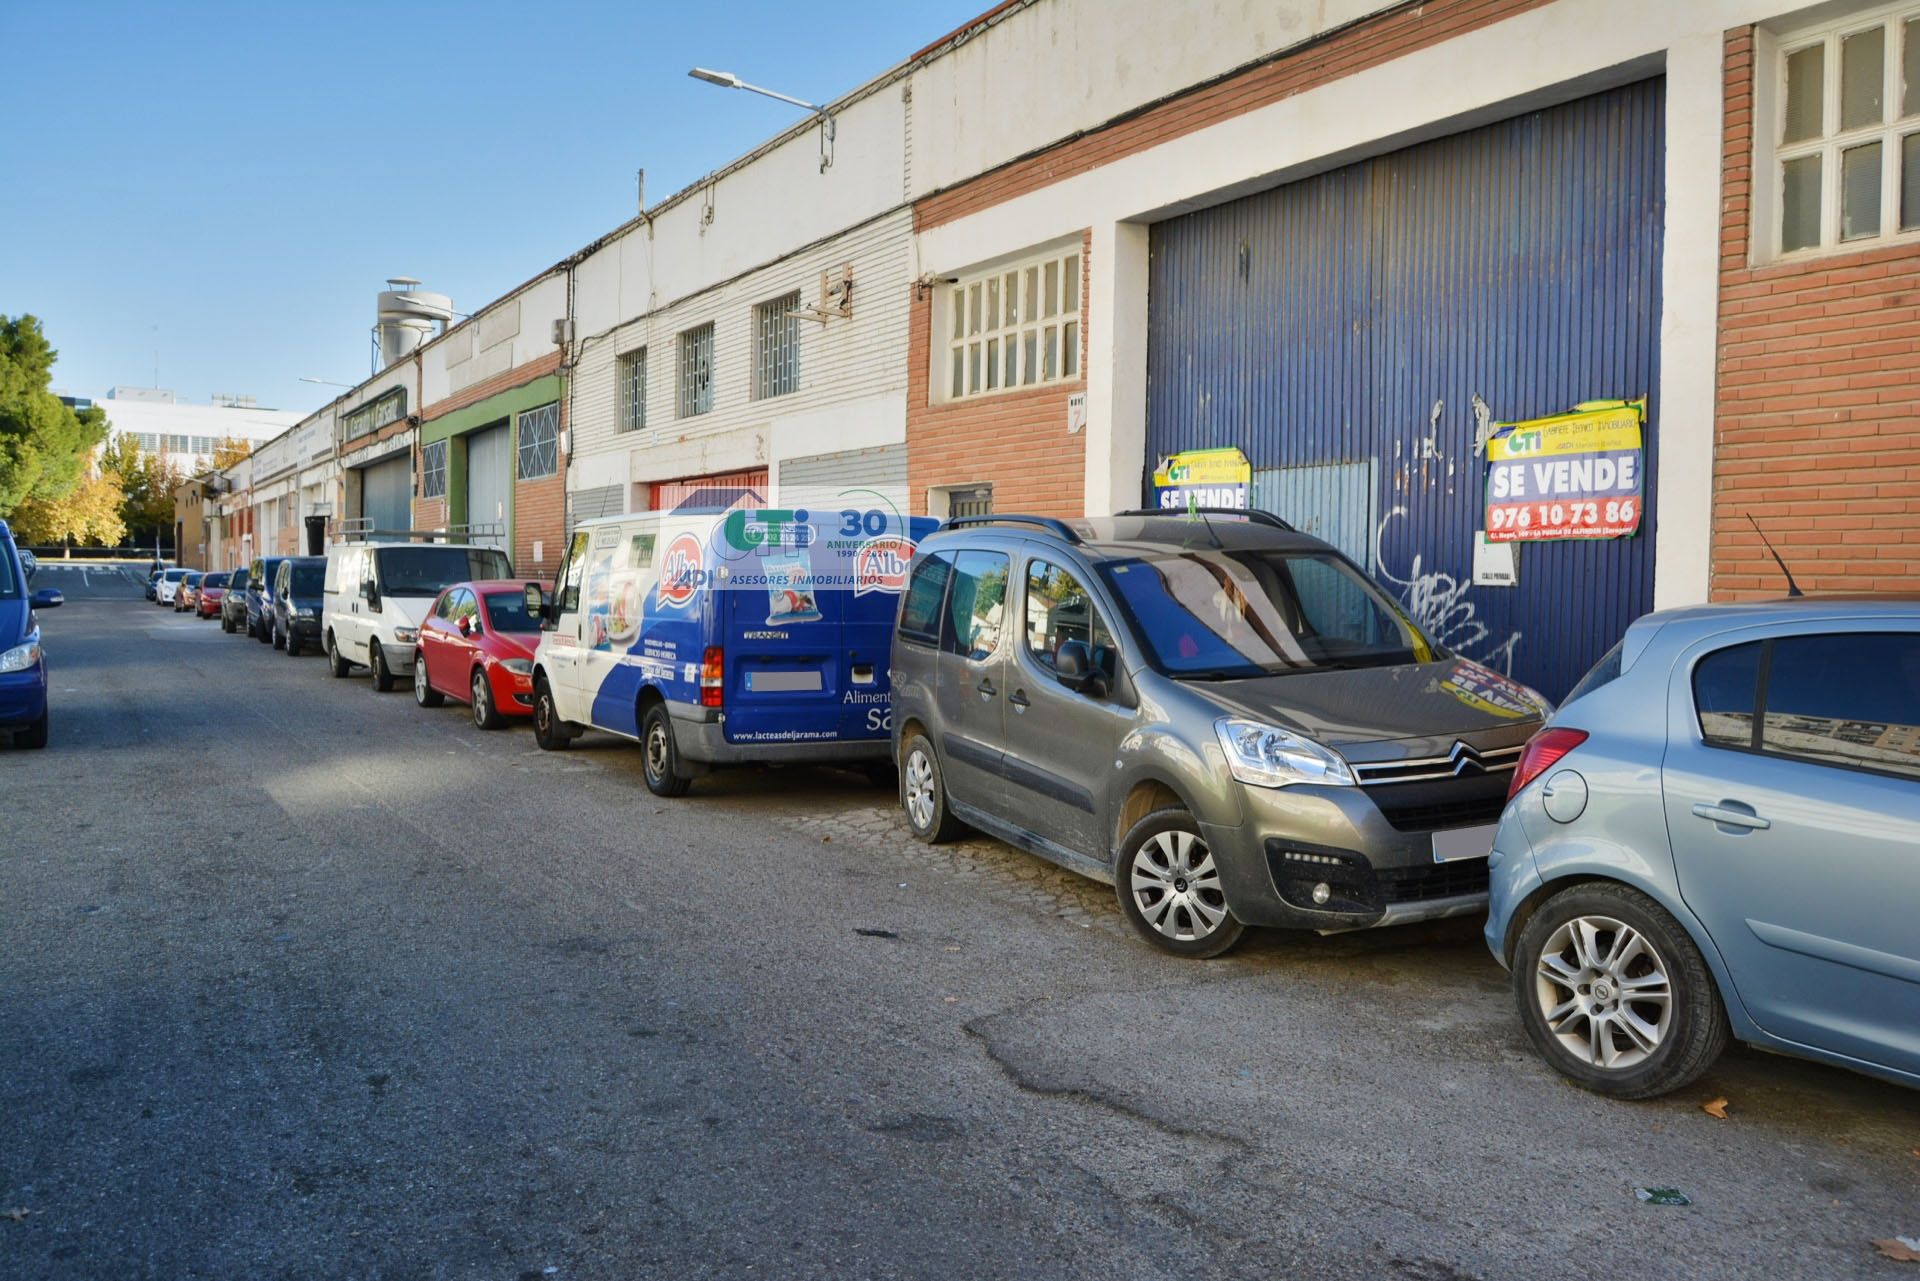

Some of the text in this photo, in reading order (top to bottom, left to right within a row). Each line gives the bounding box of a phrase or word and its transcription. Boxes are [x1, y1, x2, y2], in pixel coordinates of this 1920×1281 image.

[1493, 456, 1635, 498] SE VENDE
[1160, 487, 1245, 510] SE VENDE
[1491, 500, 1635, 530] 976 10 73 86
[743, 631, 789, 640] TRANSIT
[733, 731, 838, 742] www.lacteasdeljarama.com
